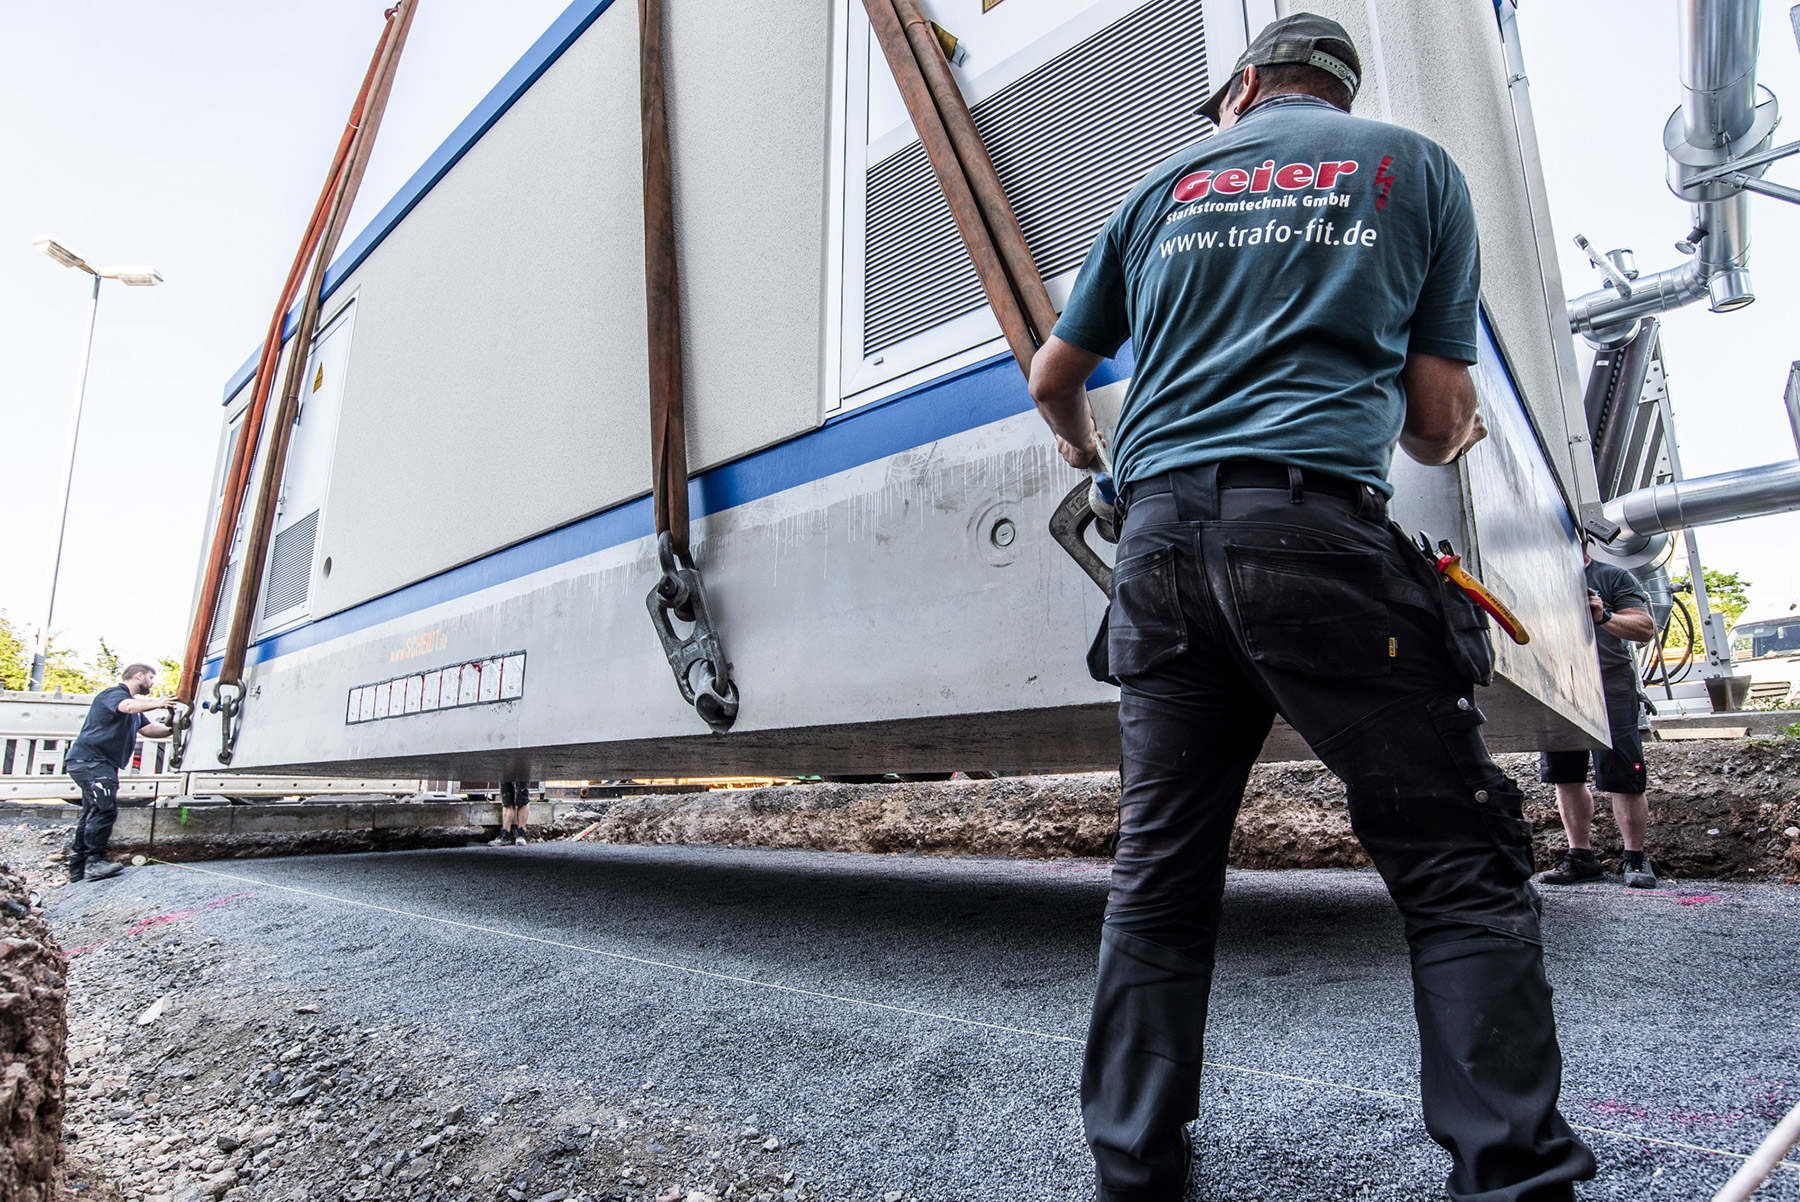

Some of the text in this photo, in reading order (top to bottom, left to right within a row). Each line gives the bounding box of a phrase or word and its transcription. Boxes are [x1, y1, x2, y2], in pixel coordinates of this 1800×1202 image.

[1172, 159, 1358, 203] Geier
[1165, 193, 1350, 225] Starkstromtechnik GmbH
[1160, 218, 1377, 258] www.trafo-fit.de
[1484, 592, 1514, 623] KNIPEX
